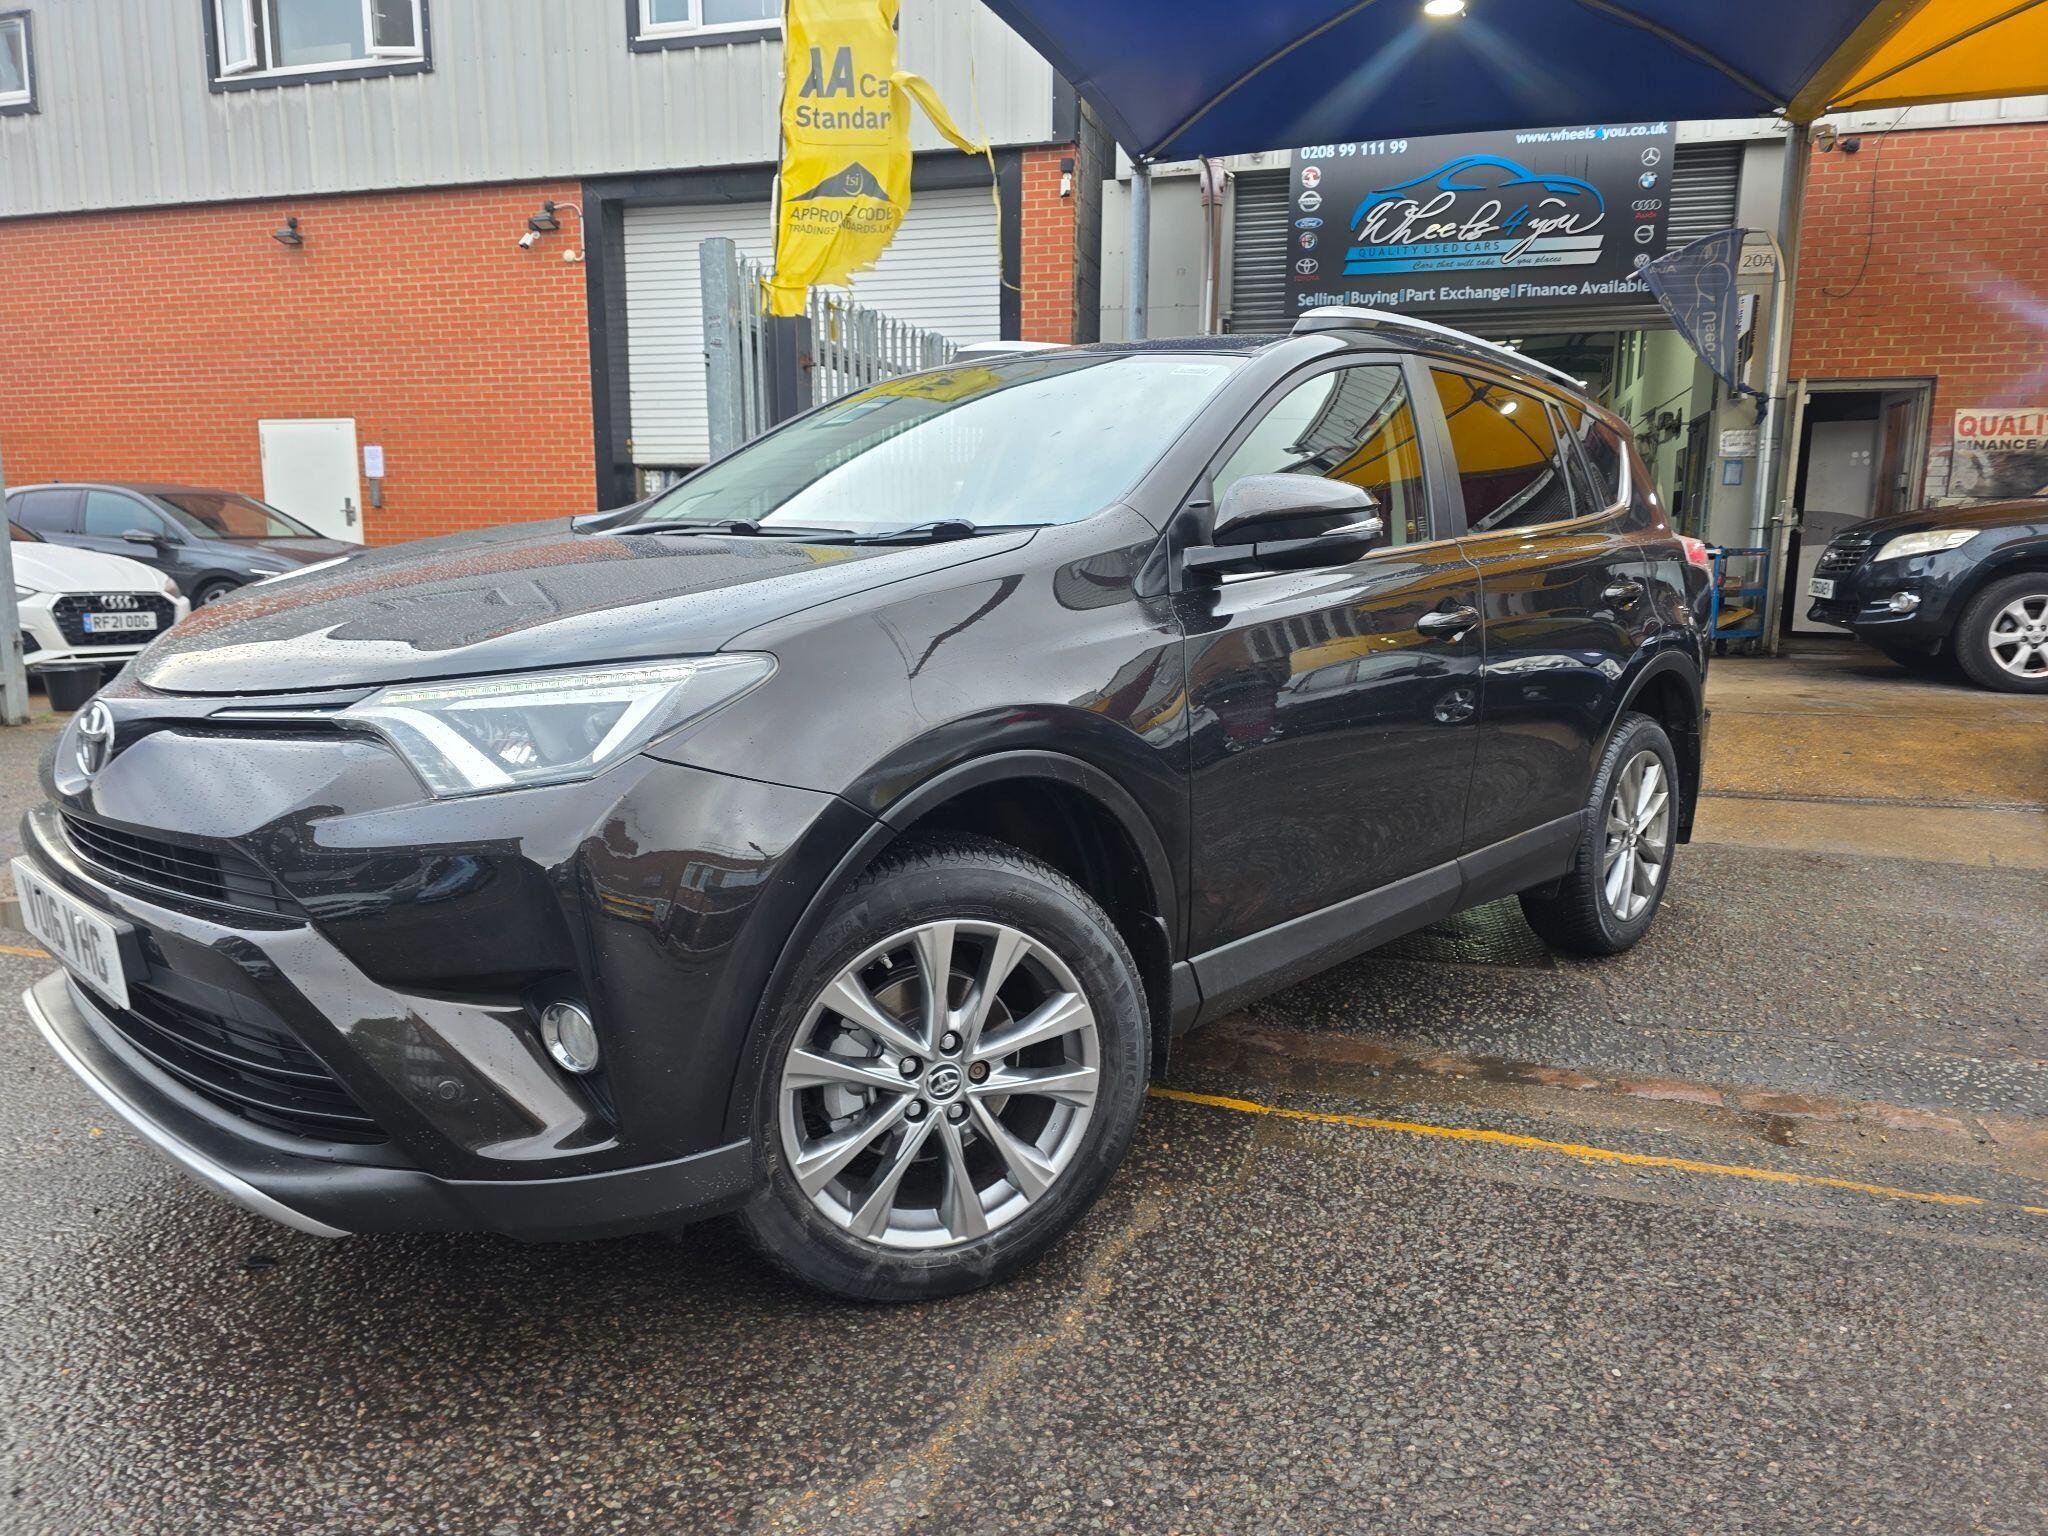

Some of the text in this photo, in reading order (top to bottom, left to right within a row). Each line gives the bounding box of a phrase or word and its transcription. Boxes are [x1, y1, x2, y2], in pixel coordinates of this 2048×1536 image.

[798, 46, 855, 98] AA
[1516, 122, 1668, 144] www.wheels4you.co.uk
[1301, 139, 1408, 159] 0208 99 111 99
[1358, 191, 1605, 264] Wheels 4 you
[1359, 241, 1499, 258] QUALITY USED CARS
[1412, 262, 1432, 270] Cars
[1436, 260, 1453, 269] that
[1457, 259, 1474, 267] will
[1477, 257, 1495, 266] take
[1535, 256, 1562, 265] places
[1743, 254, 1774, 268] 20A
[1298, 279, 1650, 306] Selling Buying Part Exchange Finance Available
[1958, 415, 2048, 437] QUALI
[1958, 439, 2037, 450] FINANCE
[93, 615, 123, 629] RF21
